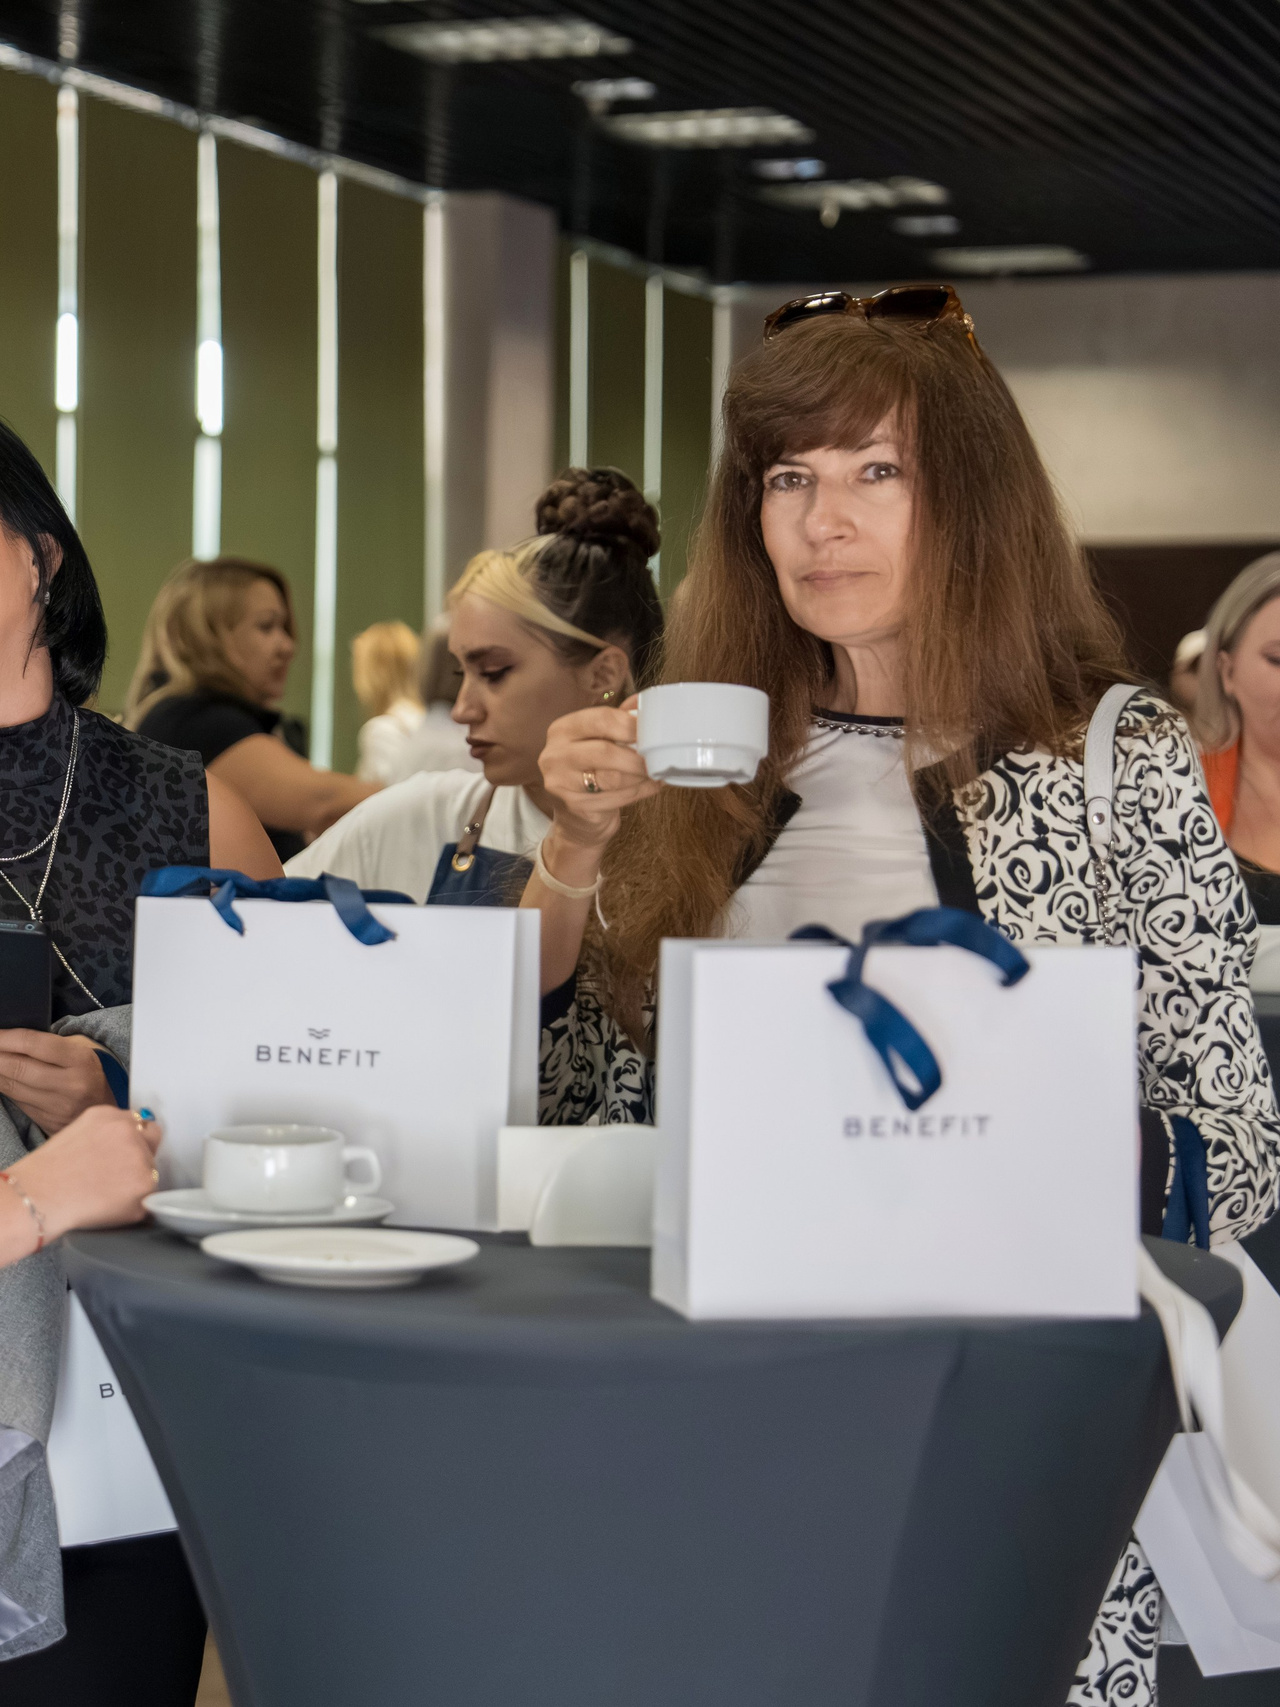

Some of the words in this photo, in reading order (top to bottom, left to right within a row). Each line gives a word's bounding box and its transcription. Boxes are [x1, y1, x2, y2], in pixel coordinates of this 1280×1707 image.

[255, 1044, 381, 1068] BENEFIT
[843, 1115, 990, 1138] BENEFIT
[99, 1382, 122, 1399] B
